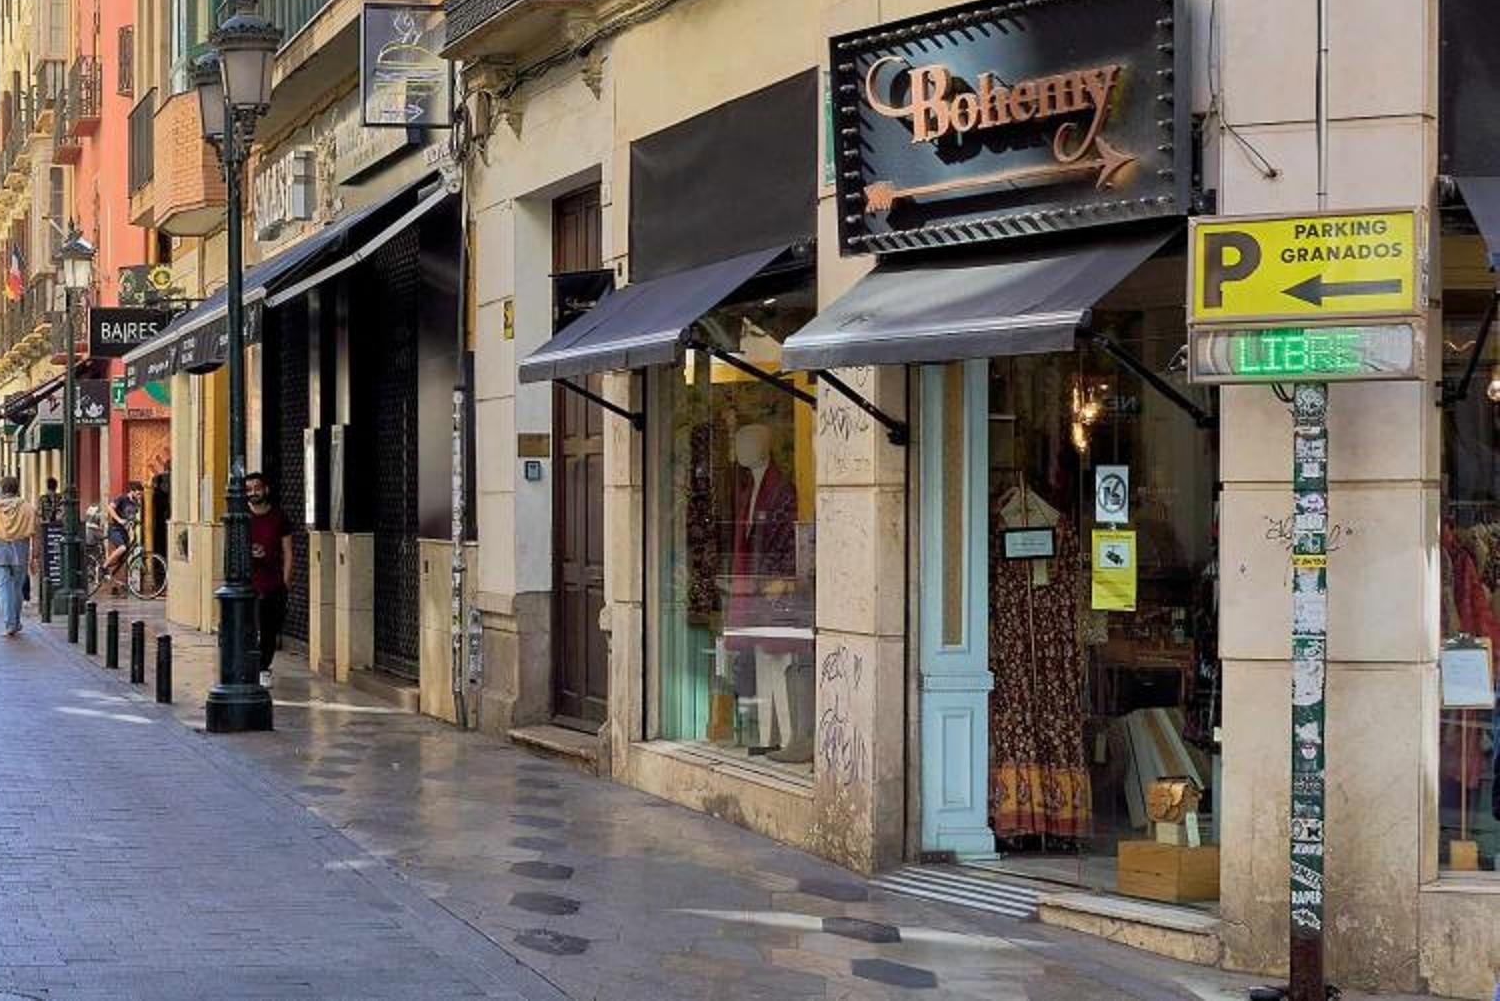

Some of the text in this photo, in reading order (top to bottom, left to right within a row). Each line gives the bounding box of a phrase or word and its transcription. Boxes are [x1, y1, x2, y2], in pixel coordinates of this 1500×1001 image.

[866, 56, 1121, 163] Bohemy
[1281, 243, 1404, 264] GRANADOS
[1294, 220, 1388, 240] PARKING
[1203, 230, 1262, 310] P
